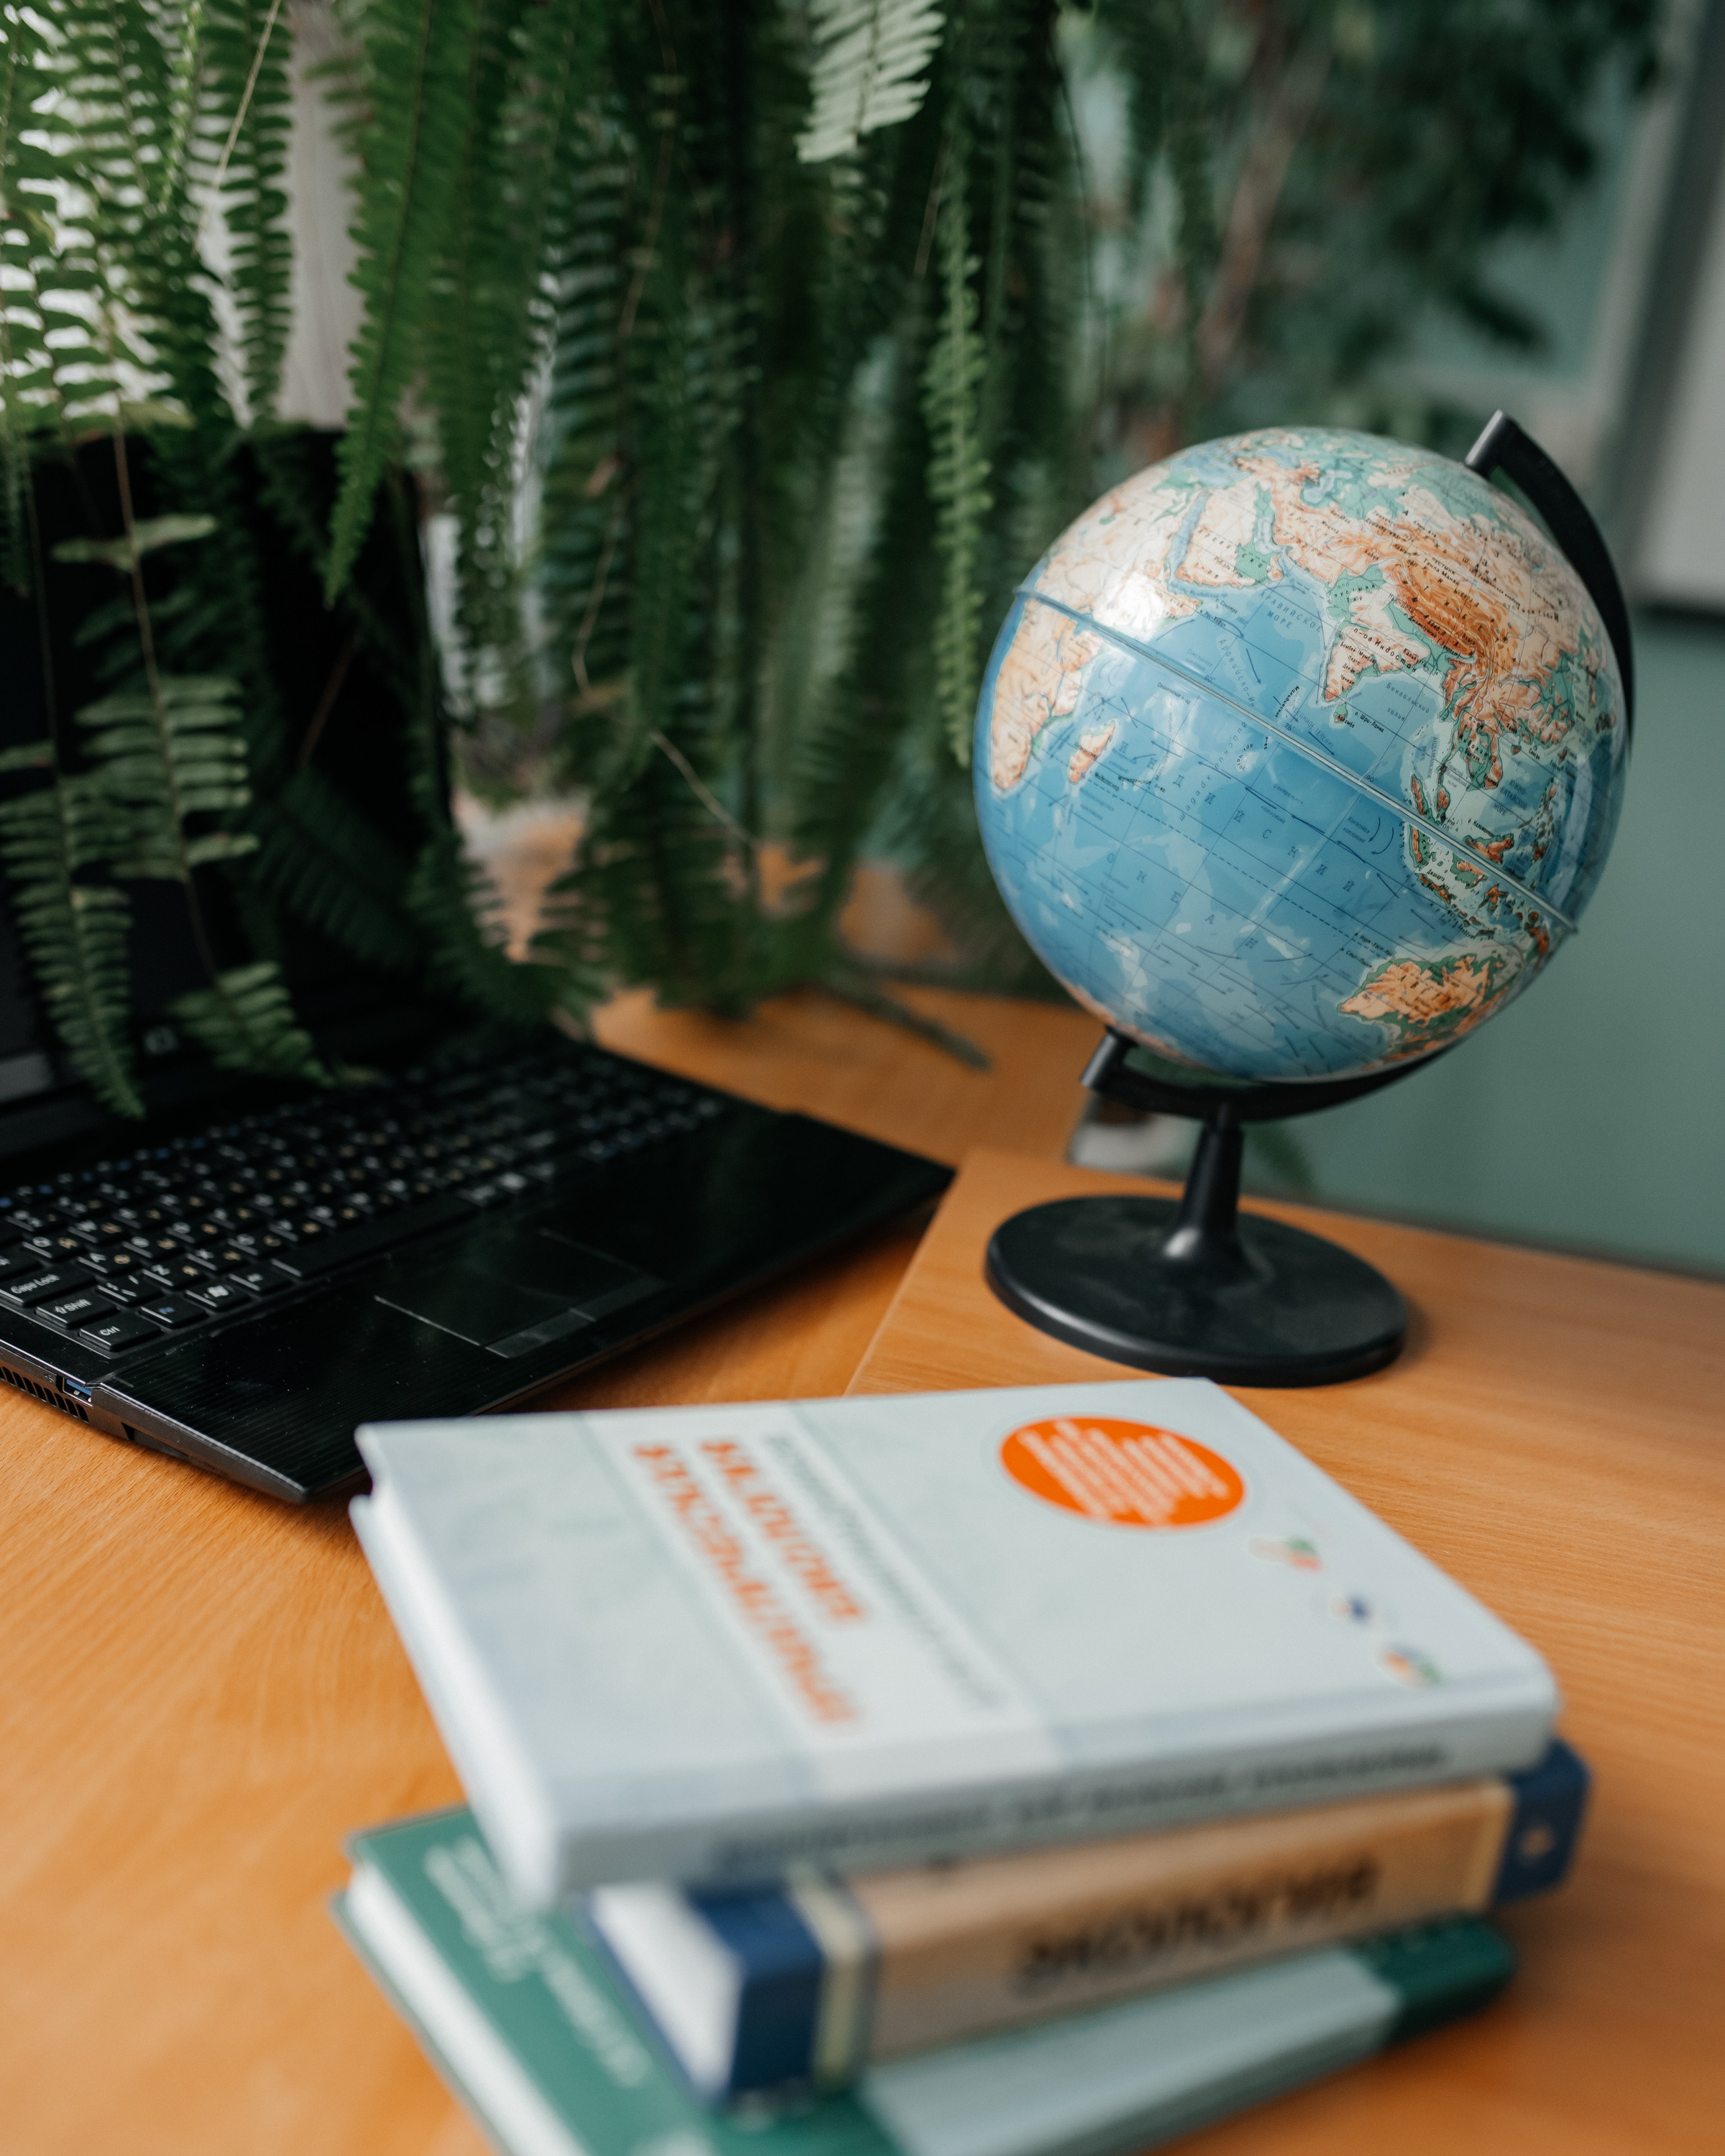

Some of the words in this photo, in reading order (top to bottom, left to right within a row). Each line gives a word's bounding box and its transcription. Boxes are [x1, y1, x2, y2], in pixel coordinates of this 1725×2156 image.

[1259, 591, 1323, 633] АРАВИЙСКОЕ
[1266, 610, 1292, 630] МОРЕ
[1353, 627, 1373, 643] п-ов
[1374, 639, 1417, 673] Индостан
[1385, 682, 1430, 714] Бенгальский
[1359, 713, 1385, 734] Шри-Ланка
[1386, 706, 1405, 723] залив
[10, 1280, 37, 1294] Caps
[34, 1273, 60, 1288] Lock
[64, 1298, 92, 1312] Shift
[99, 1326, 121, 1337] Ctrl
